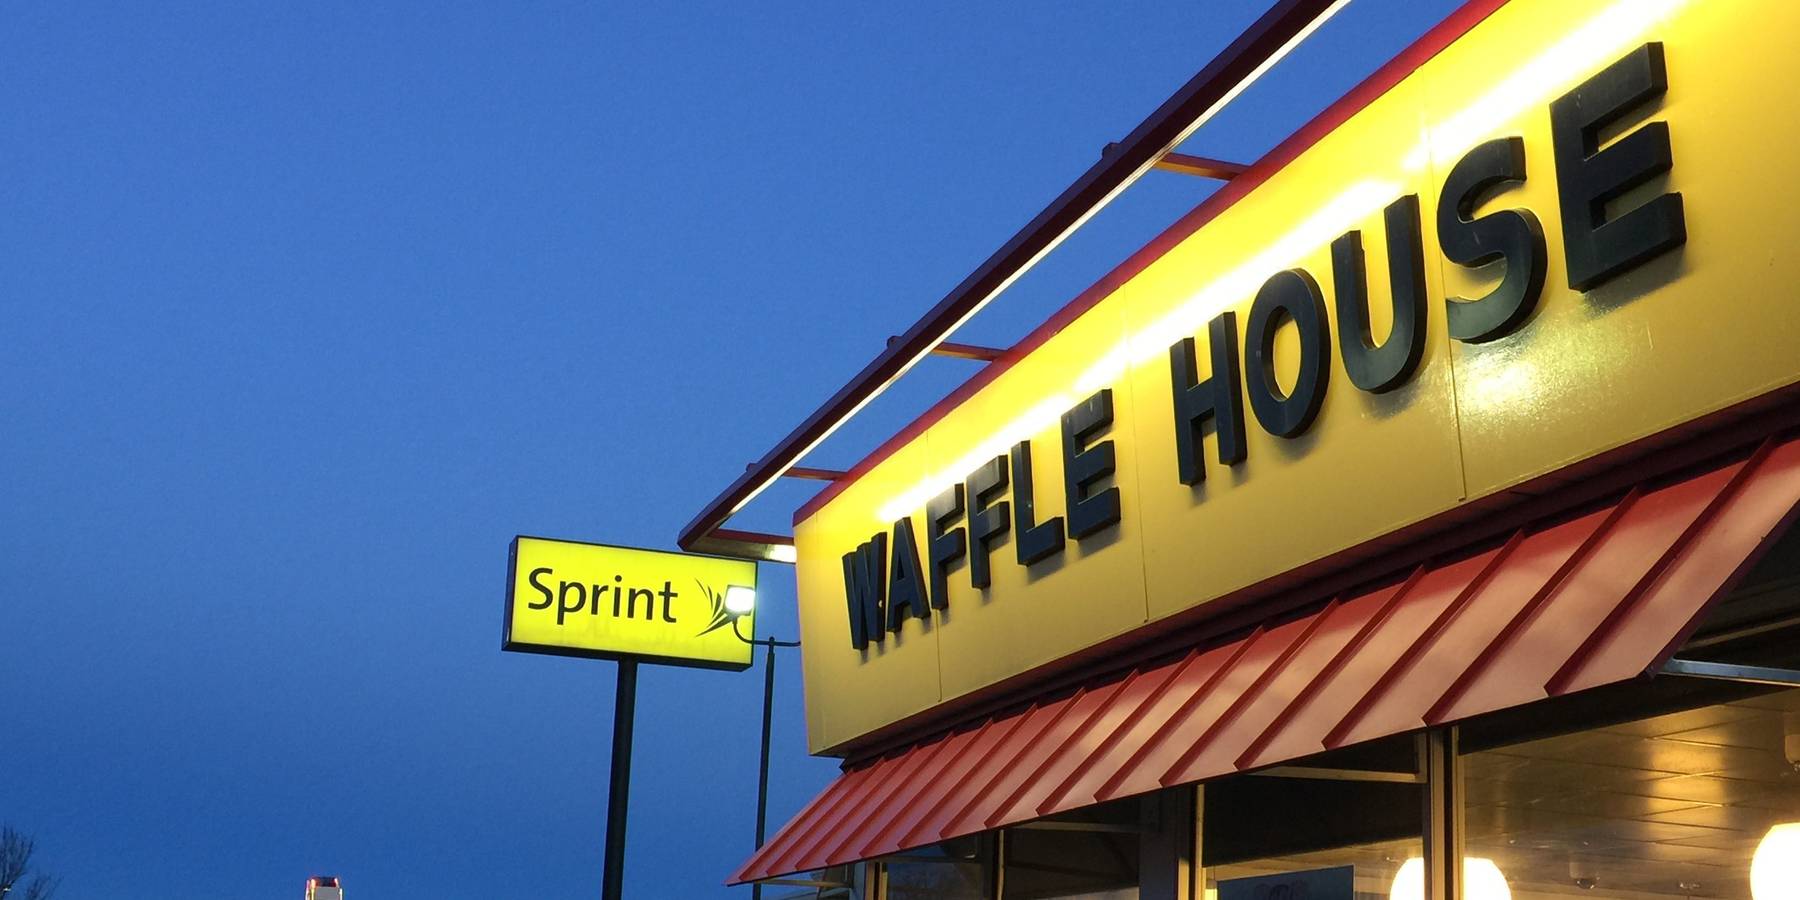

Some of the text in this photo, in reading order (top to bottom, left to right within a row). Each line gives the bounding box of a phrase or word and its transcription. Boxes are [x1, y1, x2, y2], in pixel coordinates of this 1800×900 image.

[842, 41, 1687, 650] WAFFLE HOUSE
[528, 567, 678, 625] Sprint
